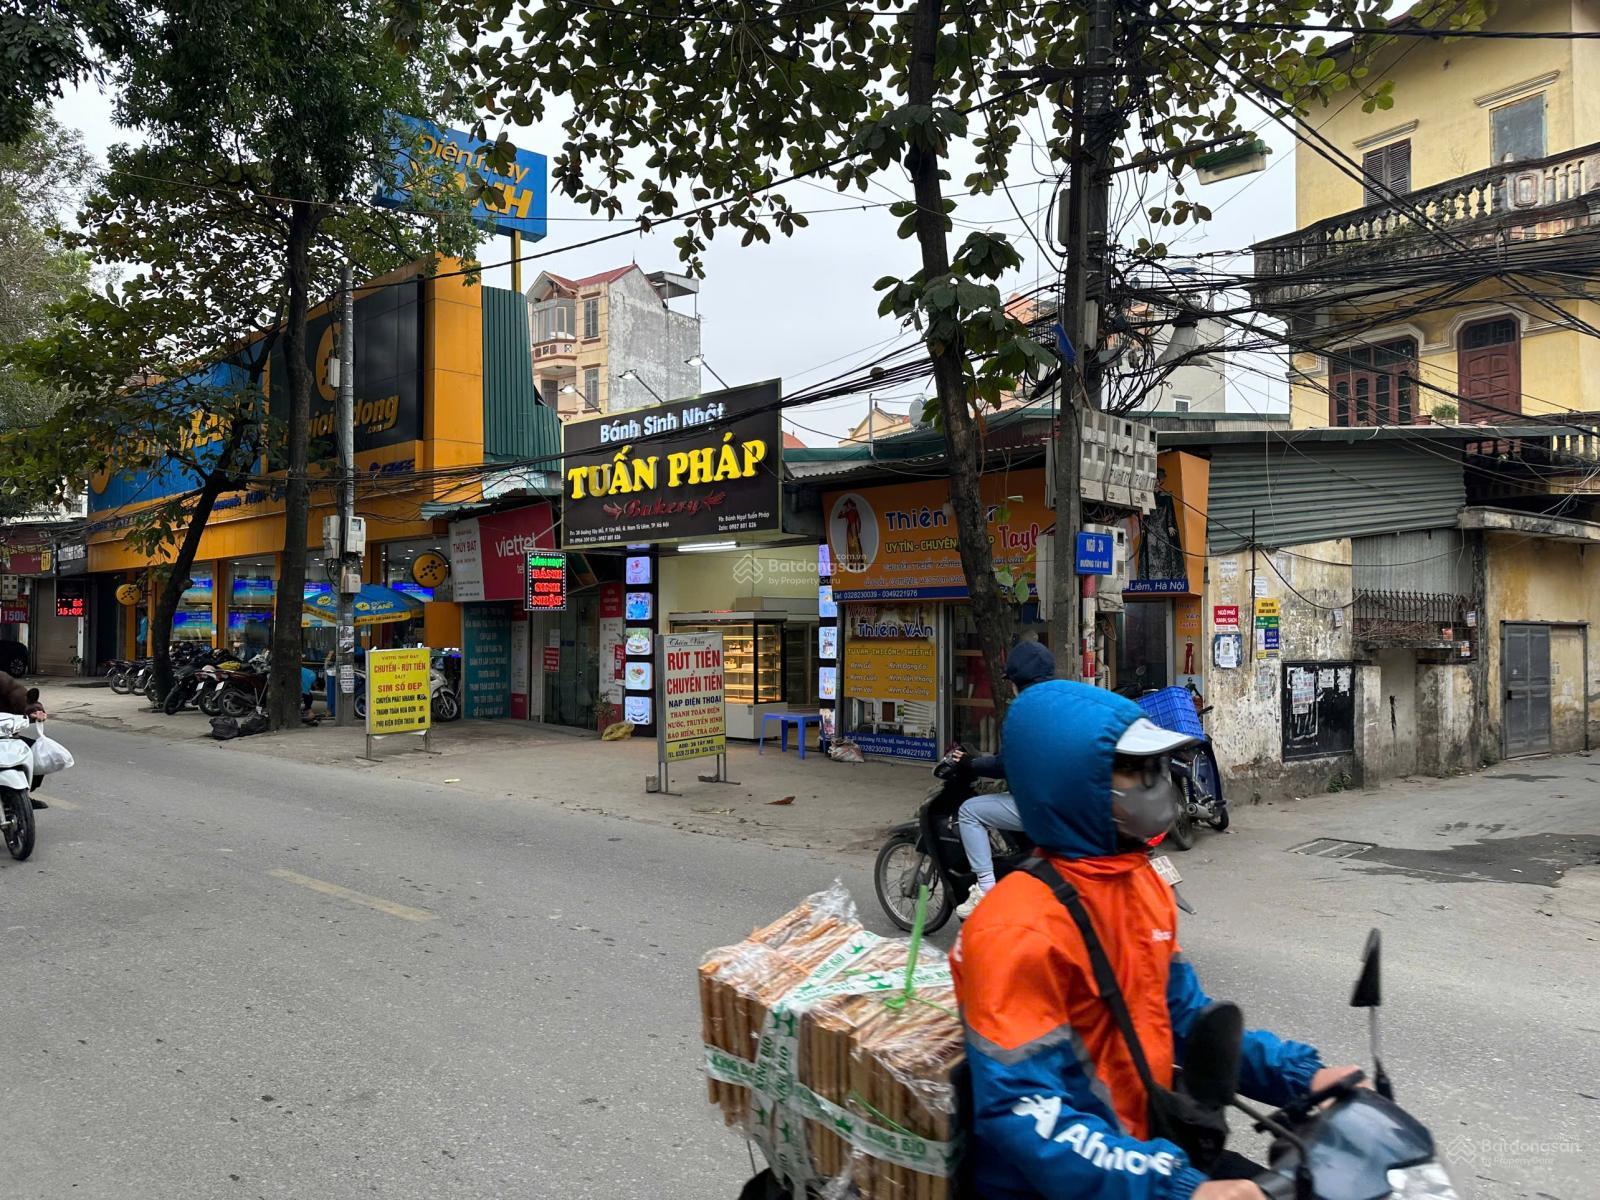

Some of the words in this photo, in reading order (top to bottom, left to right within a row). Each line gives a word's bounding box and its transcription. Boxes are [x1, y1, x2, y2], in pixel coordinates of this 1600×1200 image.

[600, 421, 642, 443] Bánh
[643, 411, 679, 436] Sinh
[567, 444, 660, 500] TUẤN
[667, 431, 768, 488] PHÁP
[885, 505, 948, 532] Thiên
[496, 532, 536, 558] viettel
[898, 538, 914, 554] TÍN
[532, 567, 562, 579] BÁNH
[534, 582, 561, 592] SINH
[1130, 581, 1152, 591] Liêm,
[1155, 582, 1167, 590] Hà
[1169, 581, 1185, 590] Nội
[844, 591, 878, 599] 0328230039
[882, 590, 918, 598] 0349221976
[858, 622, 899, 637] Thiên
[667, 648, 690, 671] RÚT
[694, 644, 720, 669] TIỀN
[402, 662, 412, 671] RÚT
[377, 684, 392, 693] SIM
[666, 670, 702, 695] CHUYỂN
[704, 669, 722, 692] TIỀN
[668, 699, 683, 710] NẠP
[684, 697, 700, 707] ĐIỆN
[702, 695, 722, 705] THOẠI
[670, 709, 690, 719] THANH
[896, 748, 932, 758] 0349221976
